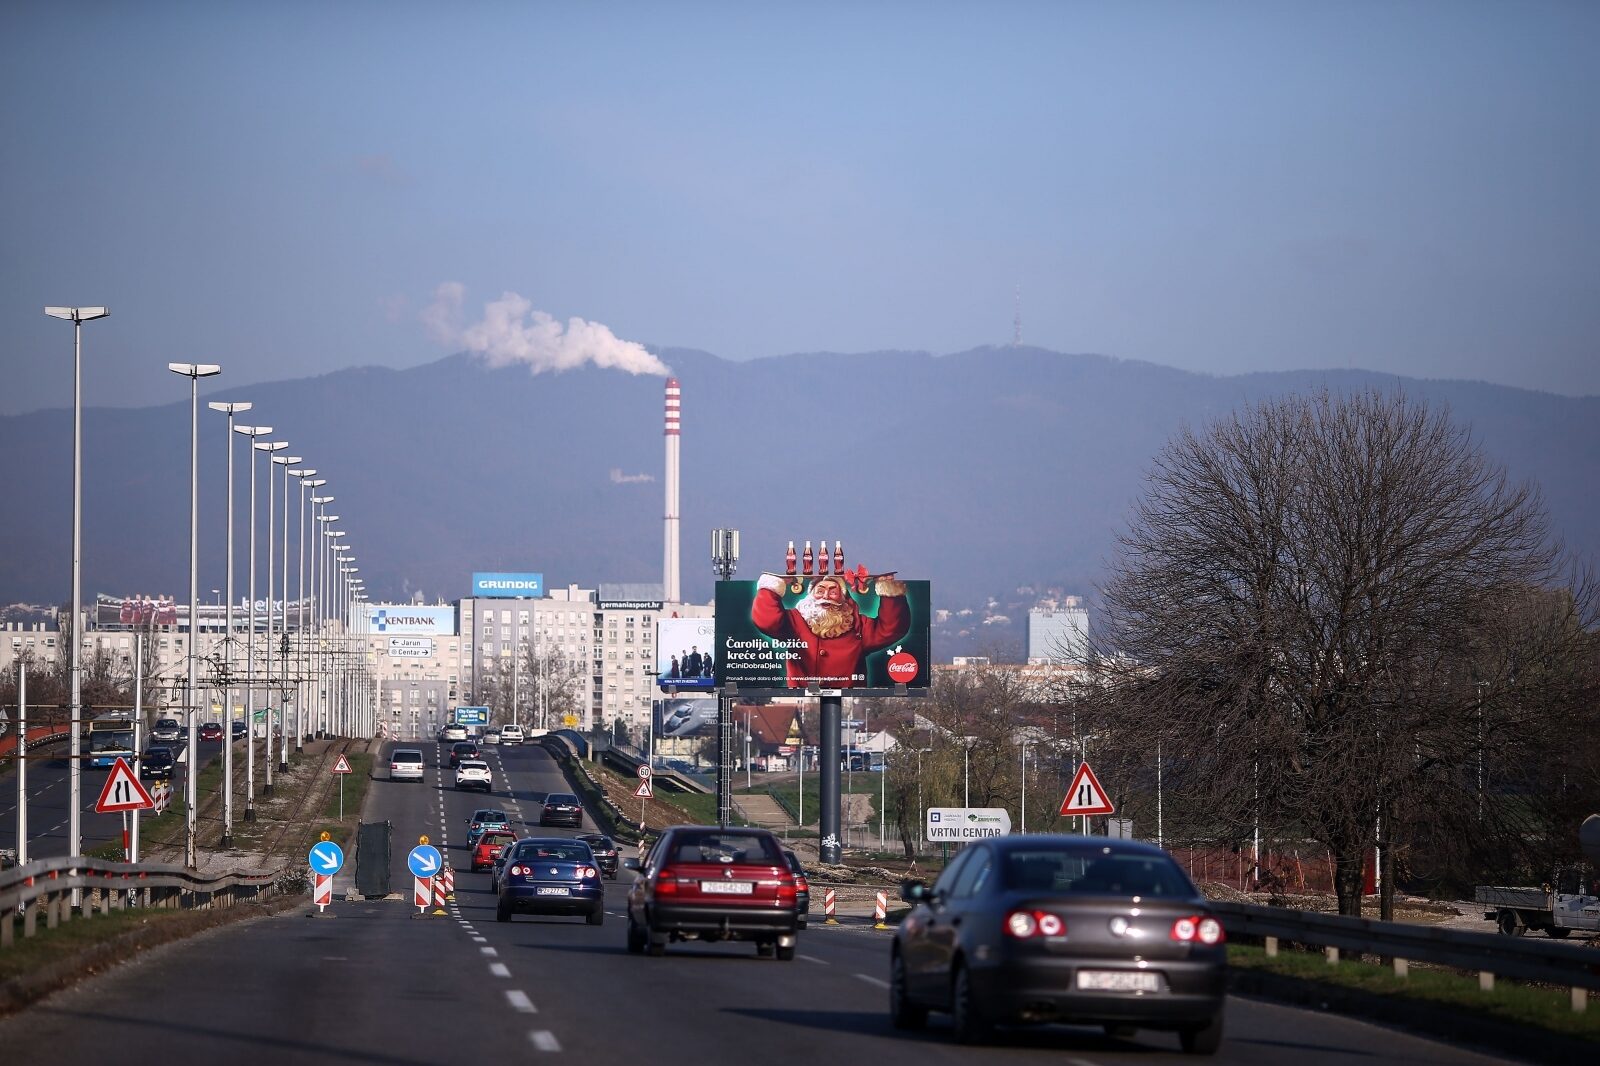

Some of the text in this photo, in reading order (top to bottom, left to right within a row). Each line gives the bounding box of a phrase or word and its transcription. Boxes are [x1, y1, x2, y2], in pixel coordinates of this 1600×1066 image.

[478, 580, 538, 589] GRUNDIG
[600, 601, 660, 609] germaniasport.hr
[385, 616, 435, 626] KENTBANK
[401, 639, 421, 647] Jarun
[726, 636, 808, 651] Čarolija Božića
[727, 649, 802, 660] kreće od tebe.
[640, 767, 649, 776] 60
[930, 827, 1001, 838] VRTNI CENTAR
